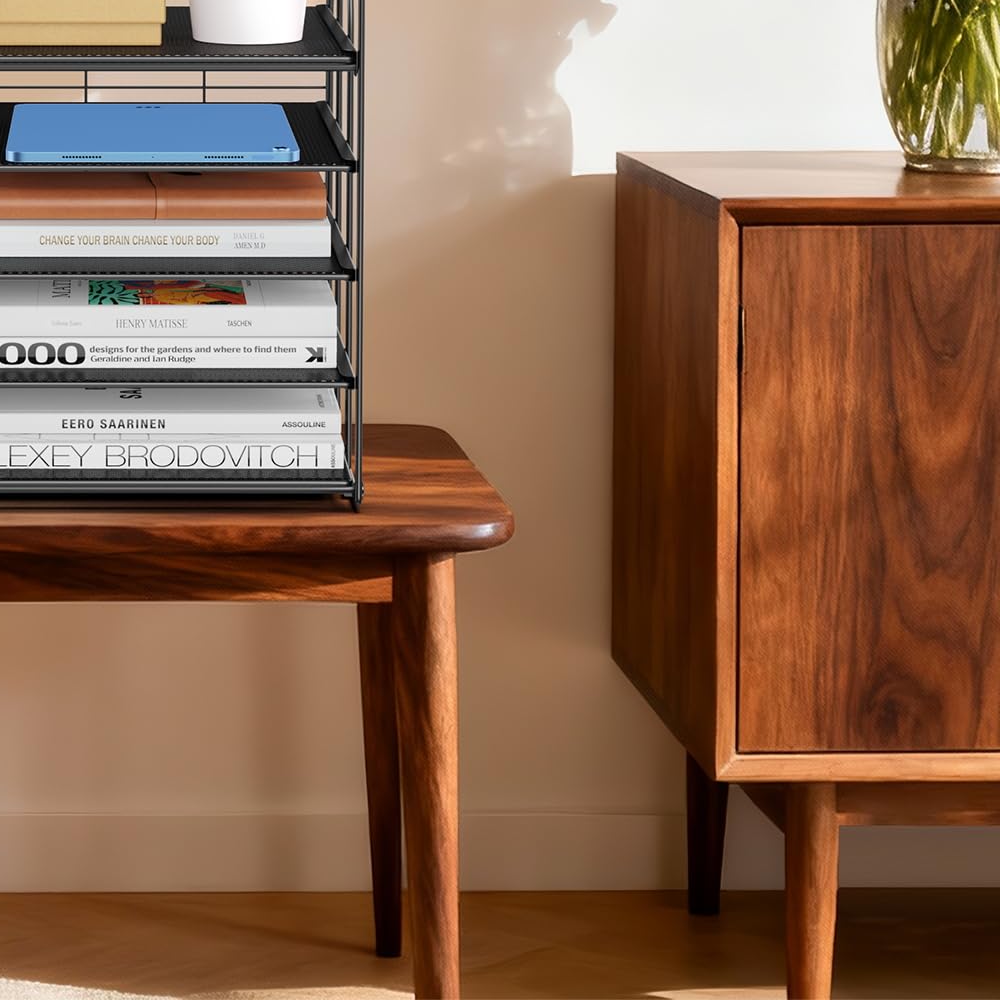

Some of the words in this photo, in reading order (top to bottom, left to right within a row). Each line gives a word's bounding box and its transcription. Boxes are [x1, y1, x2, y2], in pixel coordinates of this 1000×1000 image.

[39, 235, 75, 245] CHANGE
[77, 235, 101, 245] YOUR
[103, 235, 130, 245] BRAIN
[132, 235, 168, 245] CHANGE
[170, 235, 194, 245] YOUR
[196, 235, 220, 245] BODY
[233, 232, 258, 240] DANIEL
[115, 318, 147, 329] HENRY
[149, 318, 188, 329] MATISSE
[227, 319, 253, 327] TASCHEN
[89, 345, 124, 355] designs
[125, 345, 139, 354] for
[140, 345, 155, 354] the
[156, 345, 193, 355] gardens
[194, 345, 212, 354] and
[212, 345, 241, 354] where
[243, 346, 253, 354] to
[254, 345, 272, 354] find
[273, 345, 297, 354] them
[90, 355, 133, 363] Geraldine
[133, 355, 151, 363] and
[152, 355, 166, 363] Ian
[168, 355, 196, 364] Rudge
[62, 418, 95, 429] EERO
[100, 418, 166, 429] SAARINEN
[105, 444, 318, 468] BRODOVITCH
